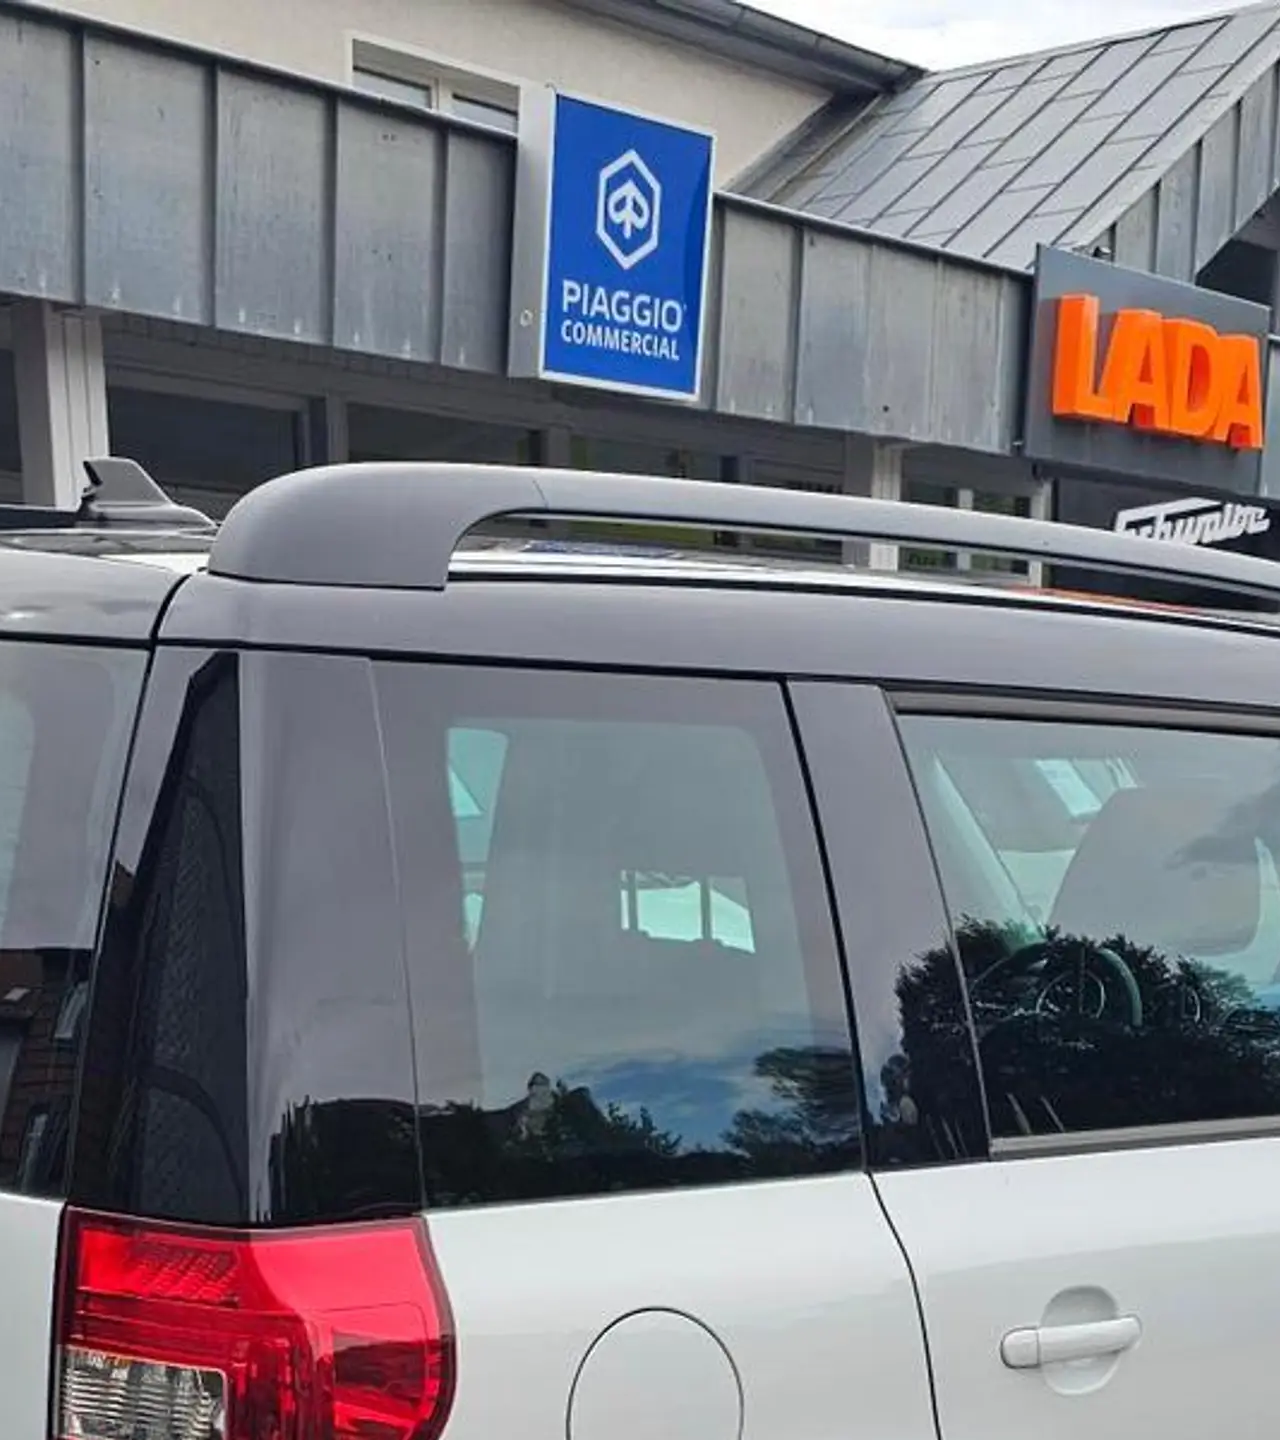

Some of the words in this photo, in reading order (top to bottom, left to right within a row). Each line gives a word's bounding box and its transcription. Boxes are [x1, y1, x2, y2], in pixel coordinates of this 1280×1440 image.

[561, 279, 684, 333] PIAGGIO
[560, 319, 680, 361] COMMERCIAL
[1053, 294, 1264, 450] LADA
